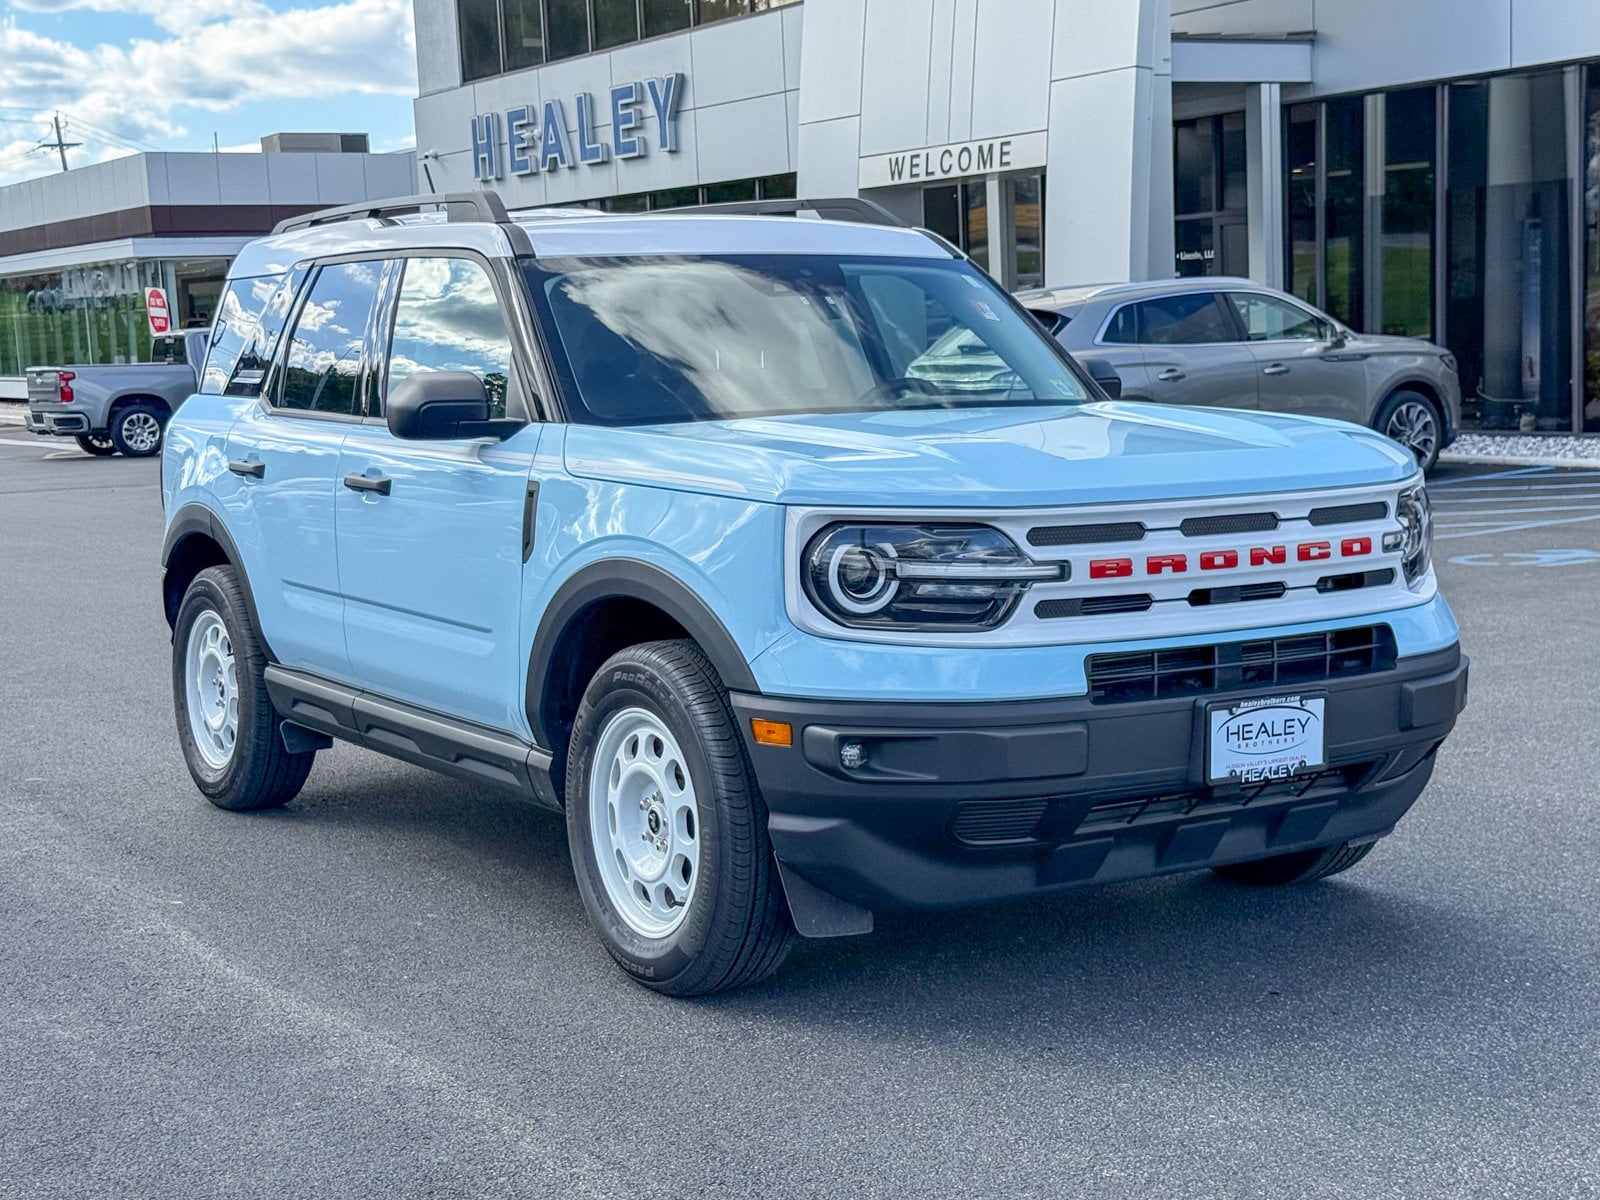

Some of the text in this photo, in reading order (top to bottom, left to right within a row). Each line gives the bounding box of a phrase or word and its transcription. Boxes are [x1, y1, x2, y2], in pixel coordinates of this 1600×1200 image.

[470, 72, 684, 182] HEALEY
[888, 140, 1012, 181] WELCOME
[150, 297, 164, 307] DO NOT
[154, 318, 166, 328] ENTER
[1089, 536, 1372, 579] BRONCO
[1240, 695, 1301, 708] healeybrothers.com
[1226, 716, 1311, 743] HEALEY
[1237, 736, 1295, 749] BROTHERS
[1240, 763, 1297, 783] HEALEY
